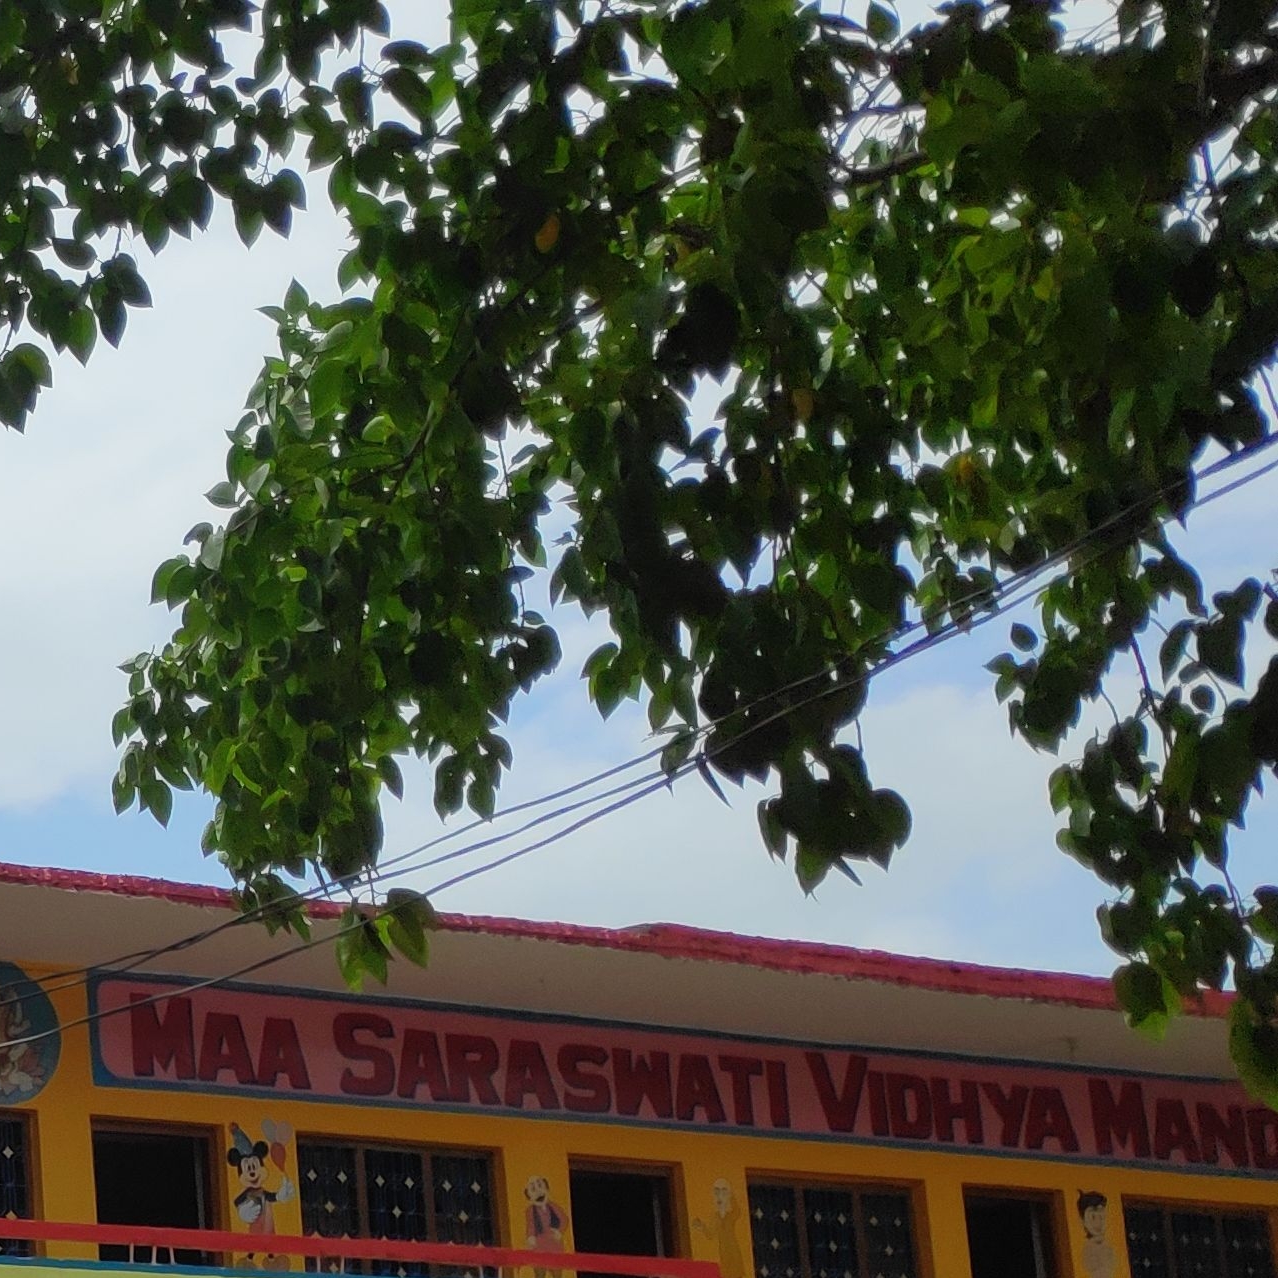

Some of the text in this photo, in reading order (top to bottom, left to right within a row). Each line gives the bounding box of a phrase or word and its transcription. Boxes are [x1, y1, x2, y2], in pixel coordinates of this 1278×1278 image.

[129, 991, 311, 1092] MAA
[333, 1012, 792, 1129] SARASWATI
[805, 1051, 1080, 1156] VIDHYA
